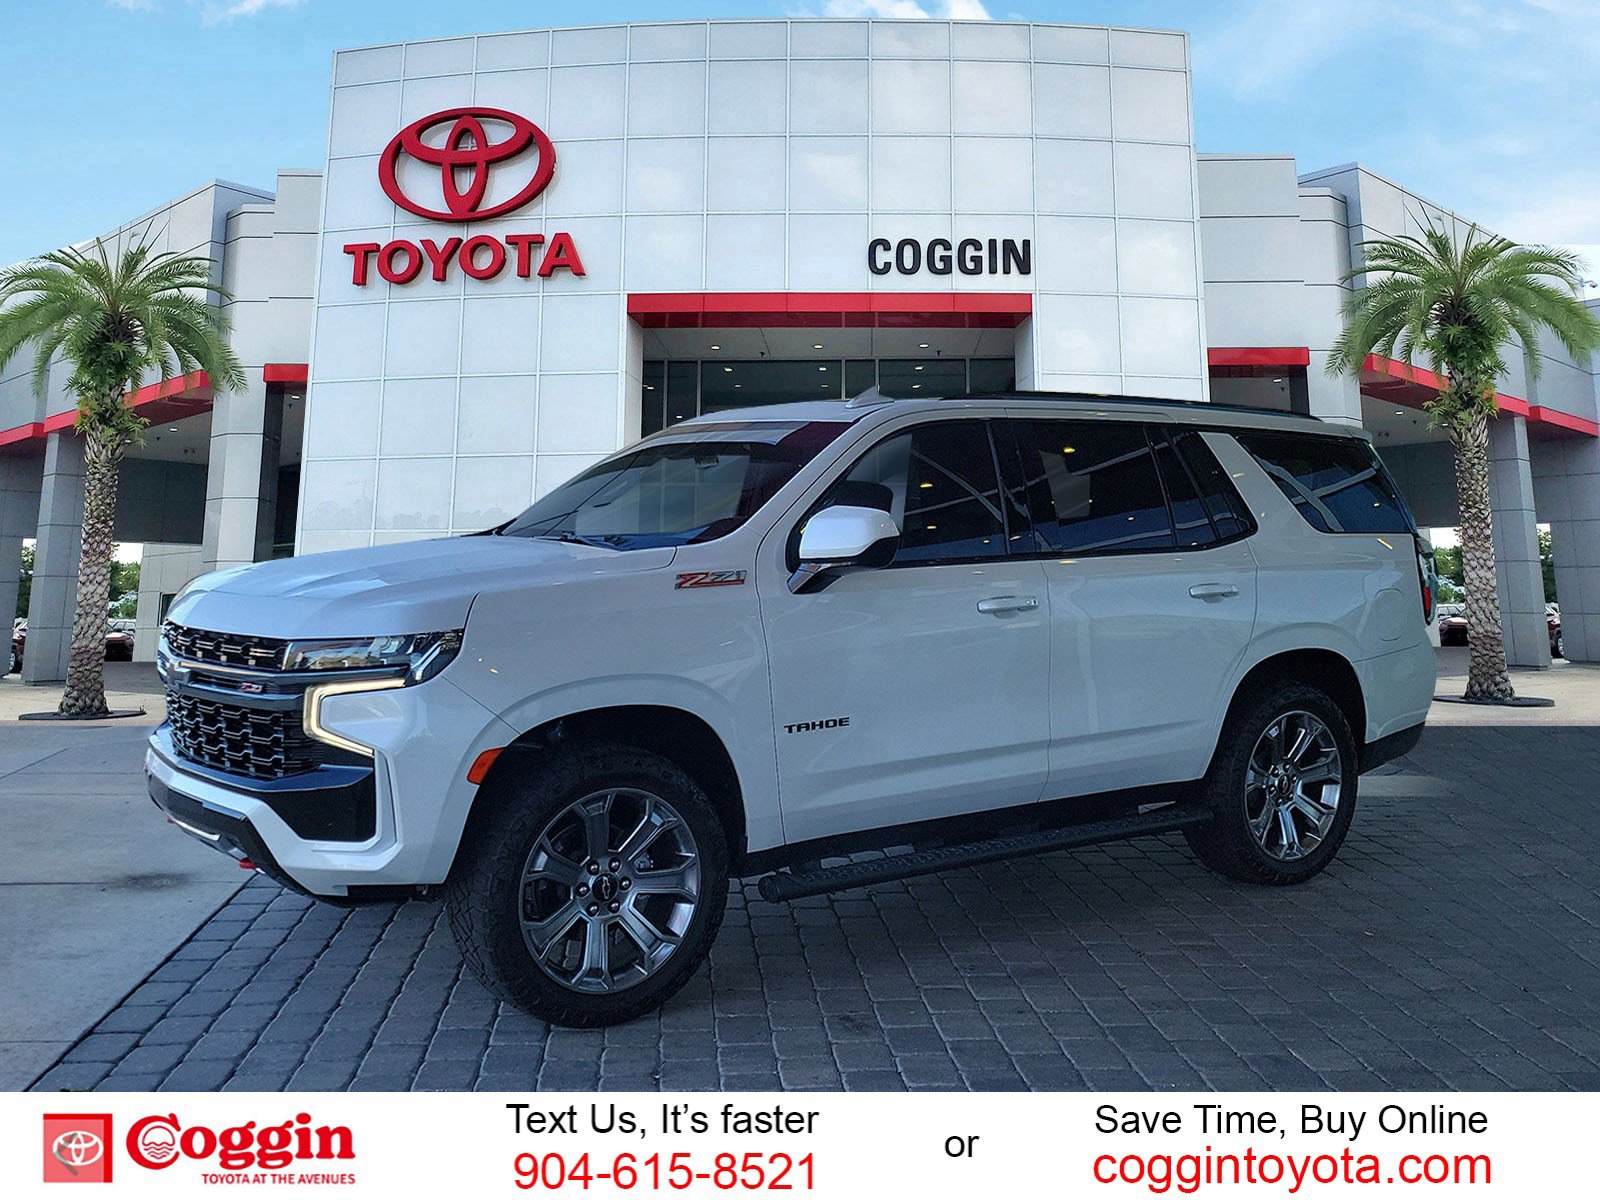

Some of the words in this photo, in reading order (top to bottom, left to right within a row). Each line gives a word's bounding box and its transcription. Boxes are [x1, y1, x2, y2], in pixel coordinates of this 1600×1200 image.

[343, 232, 586, 286] TOYOTA
[868, 238, 1032, 276] COGGIN
[674, 569, 748, 591] Z71
[784, 717, 850, 734] TAHOE
